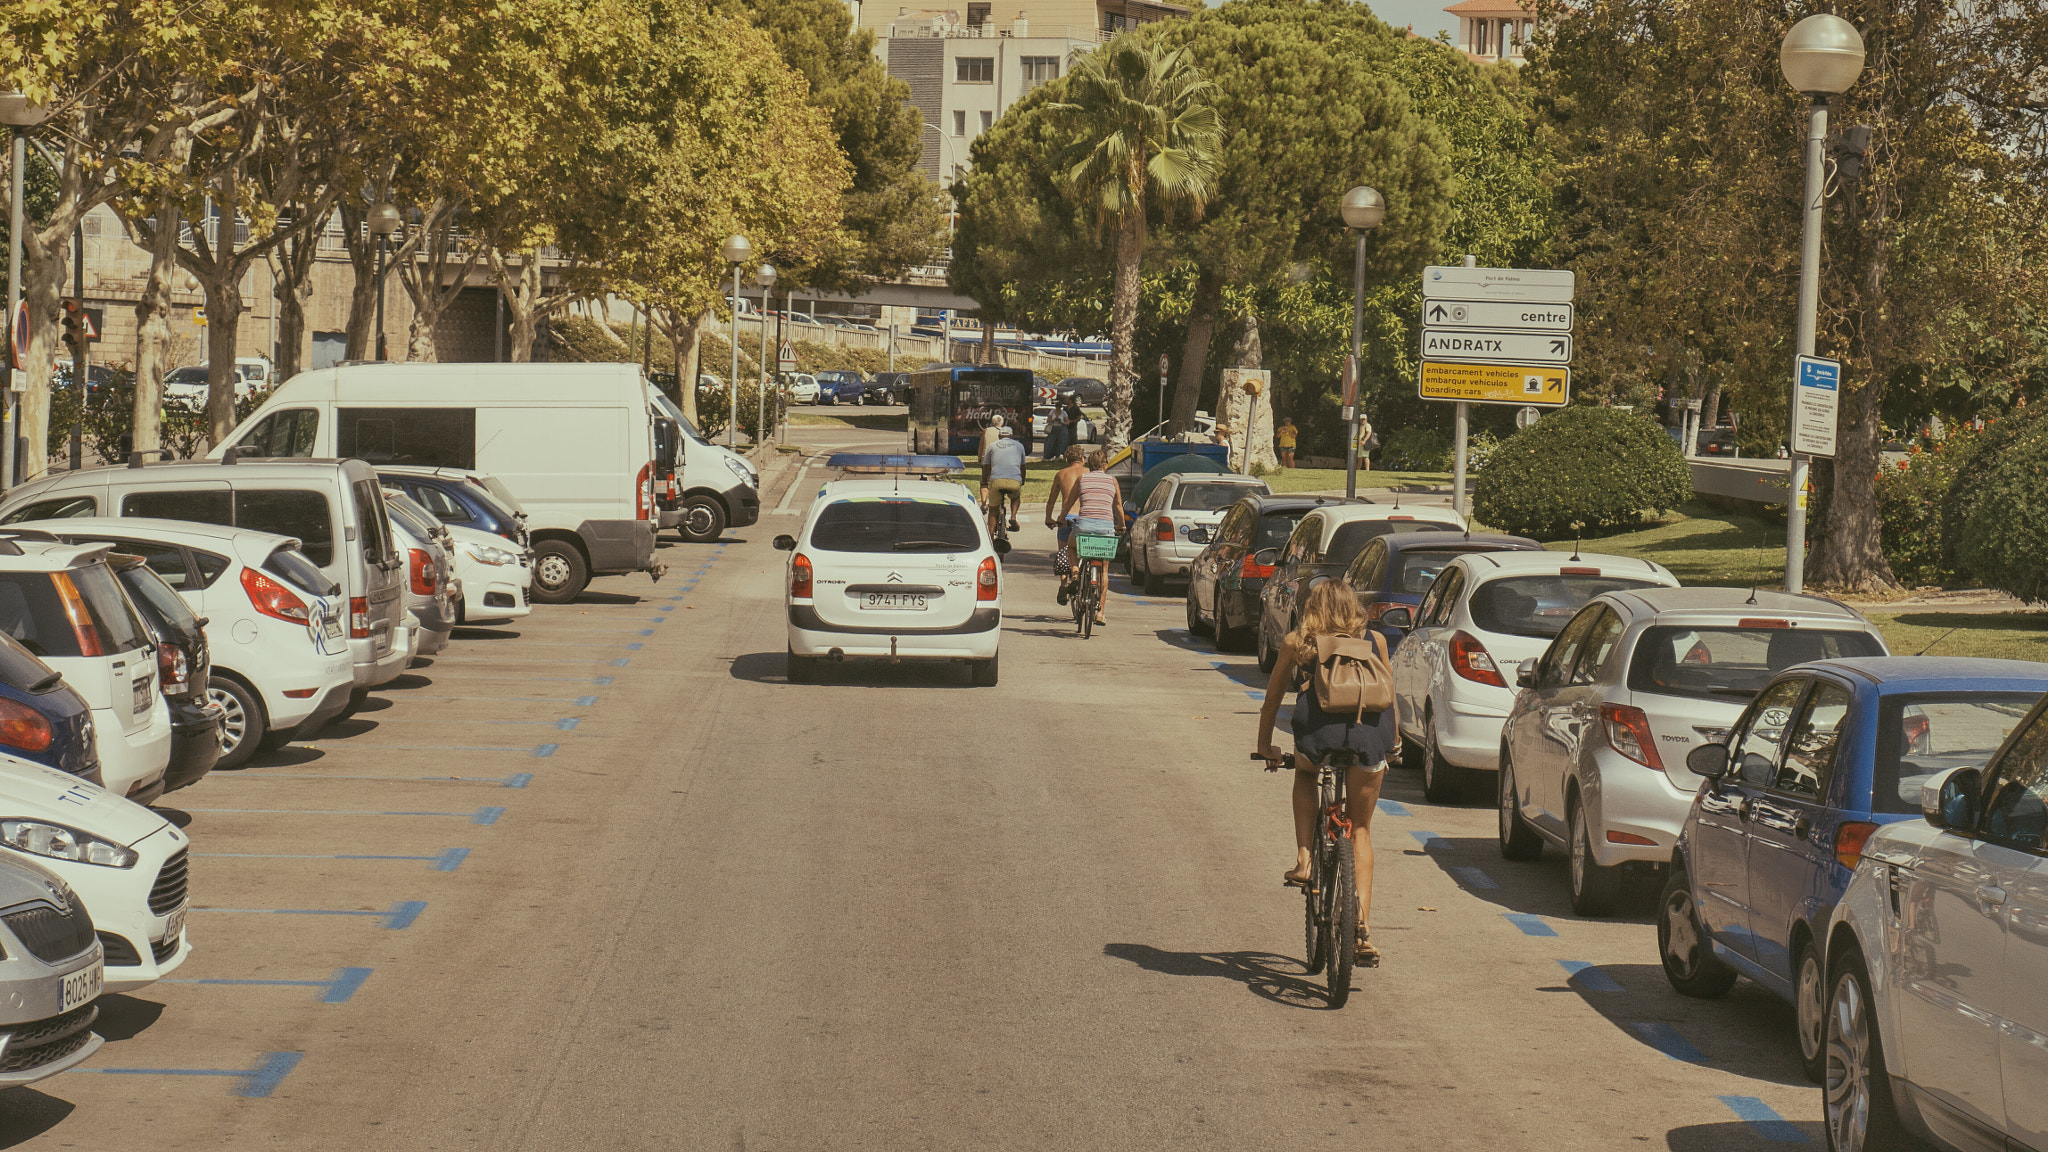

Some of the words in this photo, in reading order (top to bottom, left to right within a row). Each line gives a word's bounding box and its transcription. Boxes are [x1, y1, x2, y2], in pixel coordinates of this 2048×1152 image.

[1521, 311, 1566, 323] centre
[1428, 338, 1502, 352] ANDRATX
[1426, 367, 1482, 376] embarcament
[1486, 370, 1519, 378] vehicles
[1425, 377, 1466, 386] embarque
[1425, 386, 1461, 396] boarding
[965, 408, 992, 420] Hard
[869, 594, 898, 606] 9741
[902, 594, 925, 606] FYS
[1661, 734, 1690, 743] TOYOTA
[65, 972, 88, 1006] 8025
